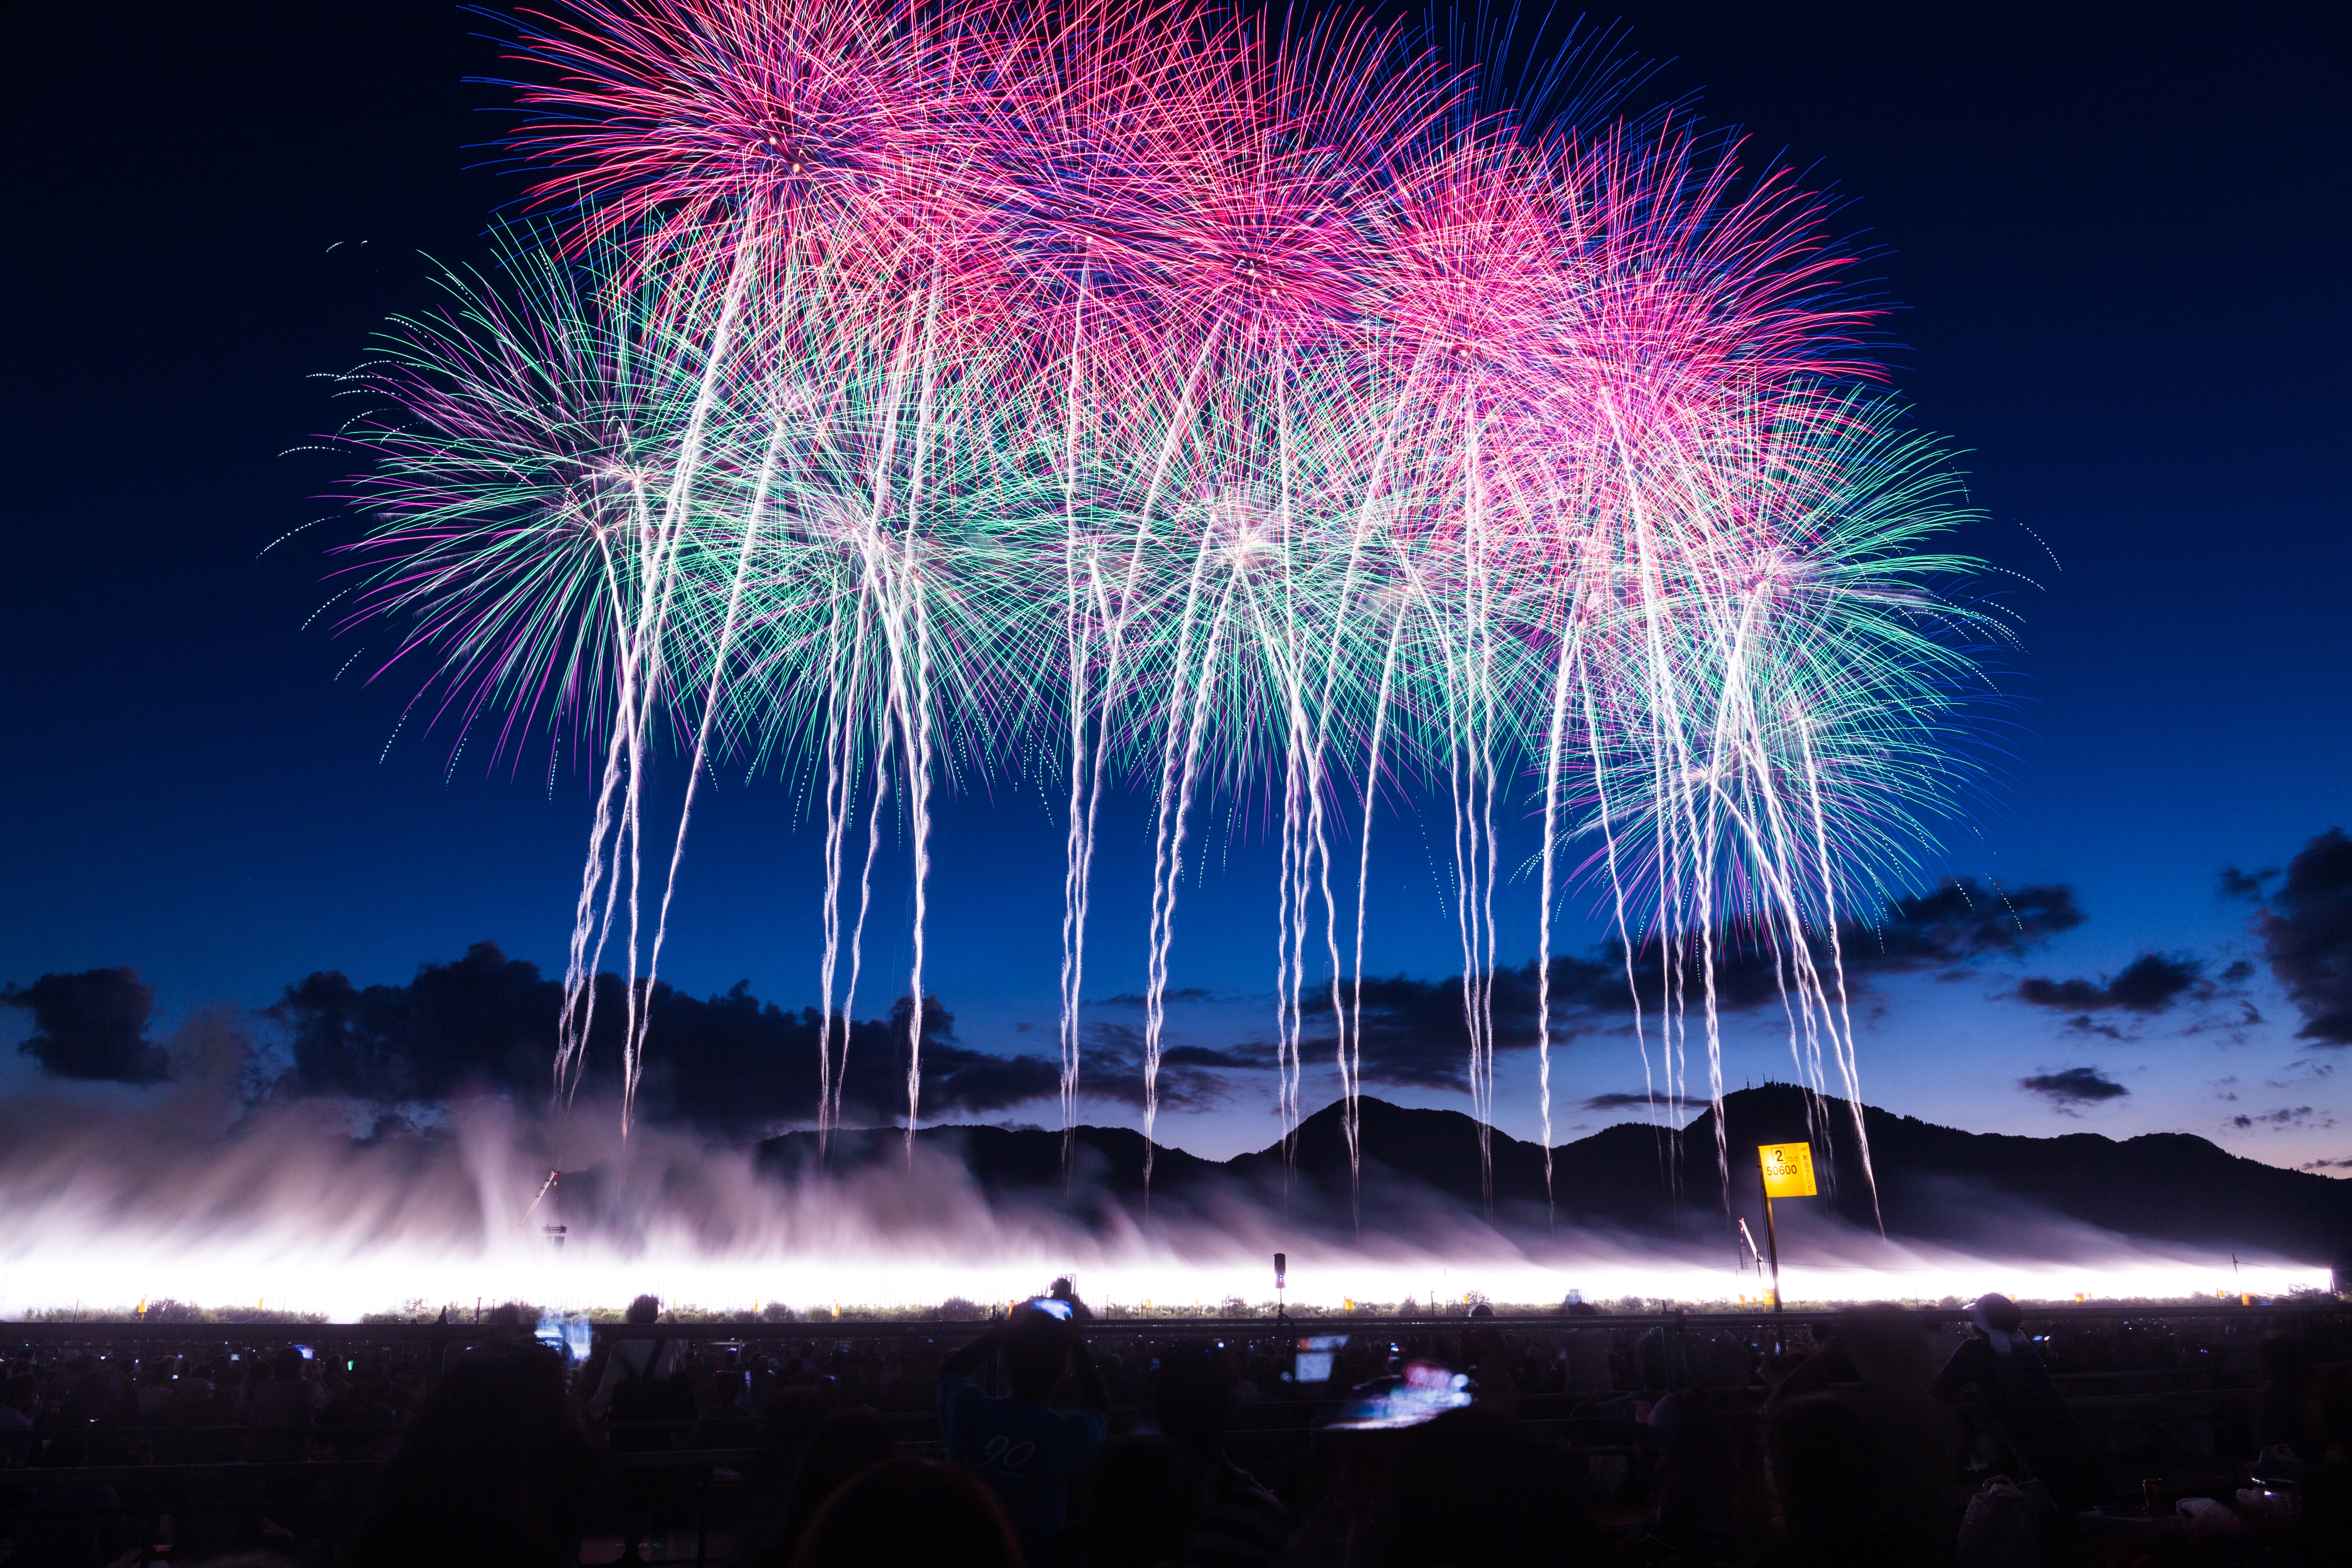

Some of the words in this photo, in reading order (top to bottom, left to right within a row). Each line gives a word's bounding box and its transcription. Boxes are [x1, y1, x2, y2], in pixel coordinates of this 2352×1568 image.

[1775, 1150, 1784, 1162] 2
[1766, 1165, 1797, 1176] 50600
[965, 1434, 1036, 1469] 90
